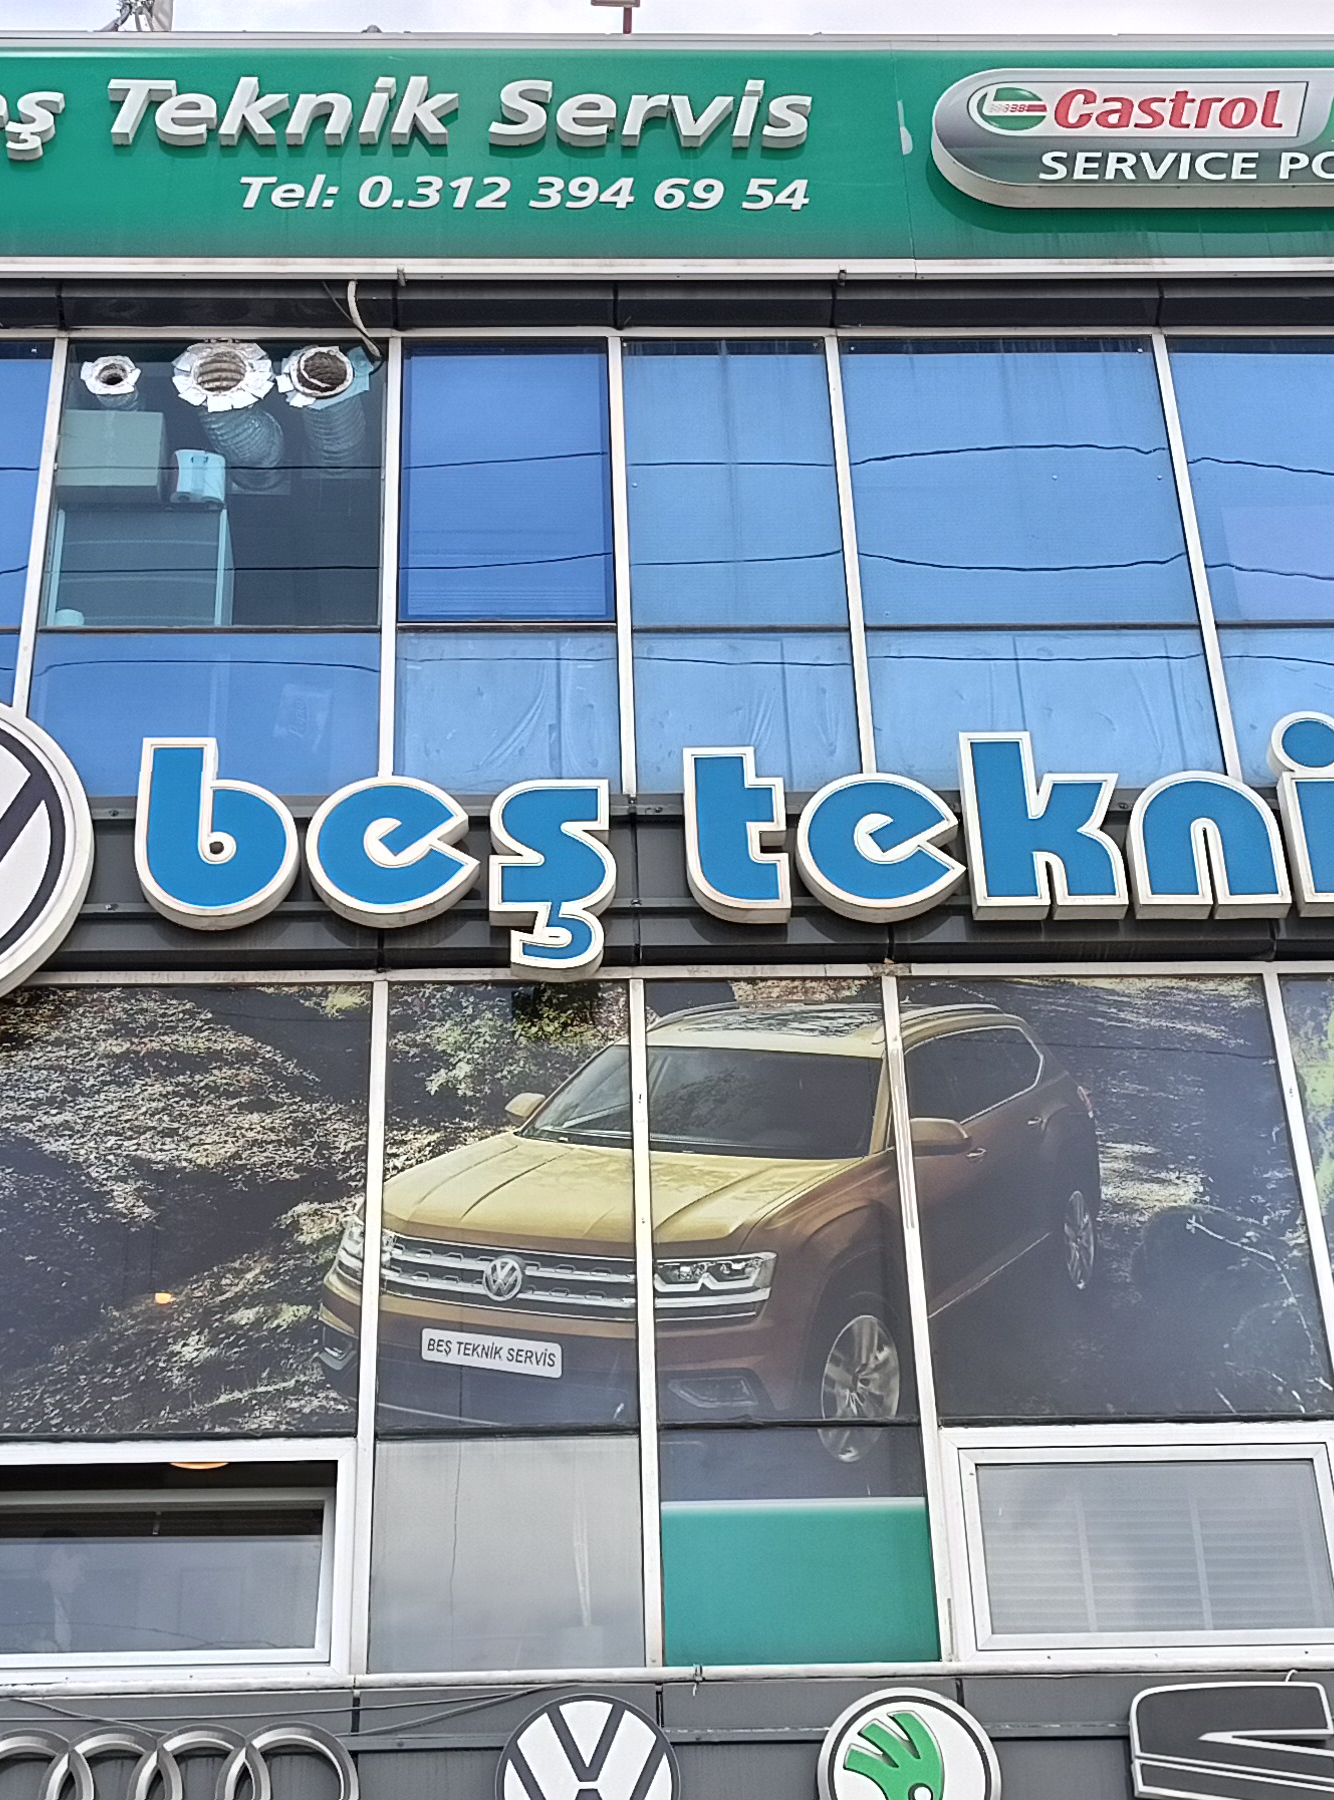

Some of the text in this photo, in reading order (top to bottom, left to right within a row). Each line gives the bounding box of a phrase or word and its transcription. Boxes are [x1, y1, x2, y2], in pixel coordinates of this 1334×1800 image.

[106, 74, 460, 147] Teknik
[488, 78, 814, 150] Servis
[1054, 88, 1284, 130] Castrol
[1038, 149, 1259, 182] SERVICE
[238, 174, 811, 213] Tel: 0.312 394 69 54
[134, 736, 617, 982] beş
[427, 1337, 453, 1357] BEŞ
